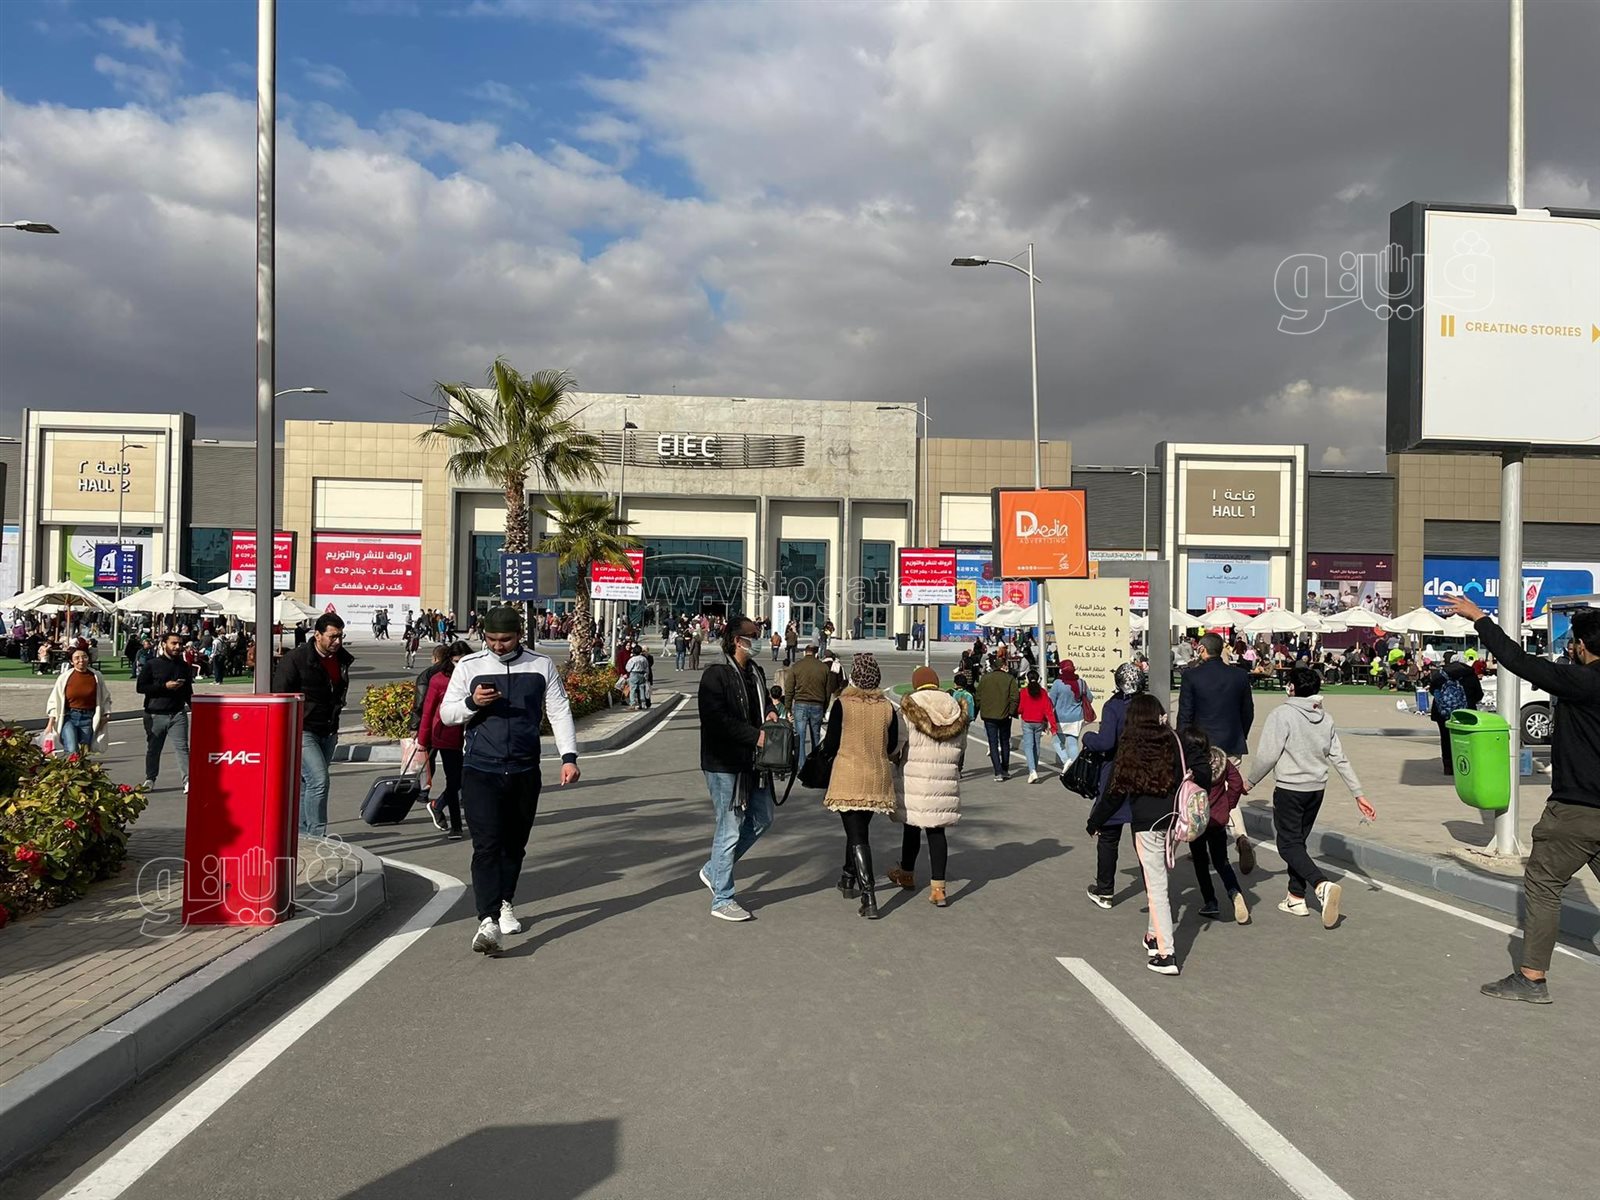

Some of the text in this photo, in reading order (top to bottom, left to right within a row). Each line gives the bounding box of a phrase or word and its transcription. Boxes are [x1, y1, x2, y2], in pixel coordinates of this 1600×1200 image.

[1465, 321, 1582, 337] CREATING STORIES
[658, 434, 716, 457] EIEC
[96, 461, 130, 475] قاعة
[79, 479, 130, 492] HALL 2
[1224, 488, 1256, 501] قاعة
[1212, 505, 1256, 517] HALL 1
[326, 550, 412, 562] الرواق للنشر والتوزيع
[506, 559, 518, 567] P1
[350, 567, 366, 576] جناح
[506, 568, 519, 577] P2
[506, 578, 519, 586] P3
[506, 587, 519, 596] P4
[208, 750, 260, 765] FAAC
